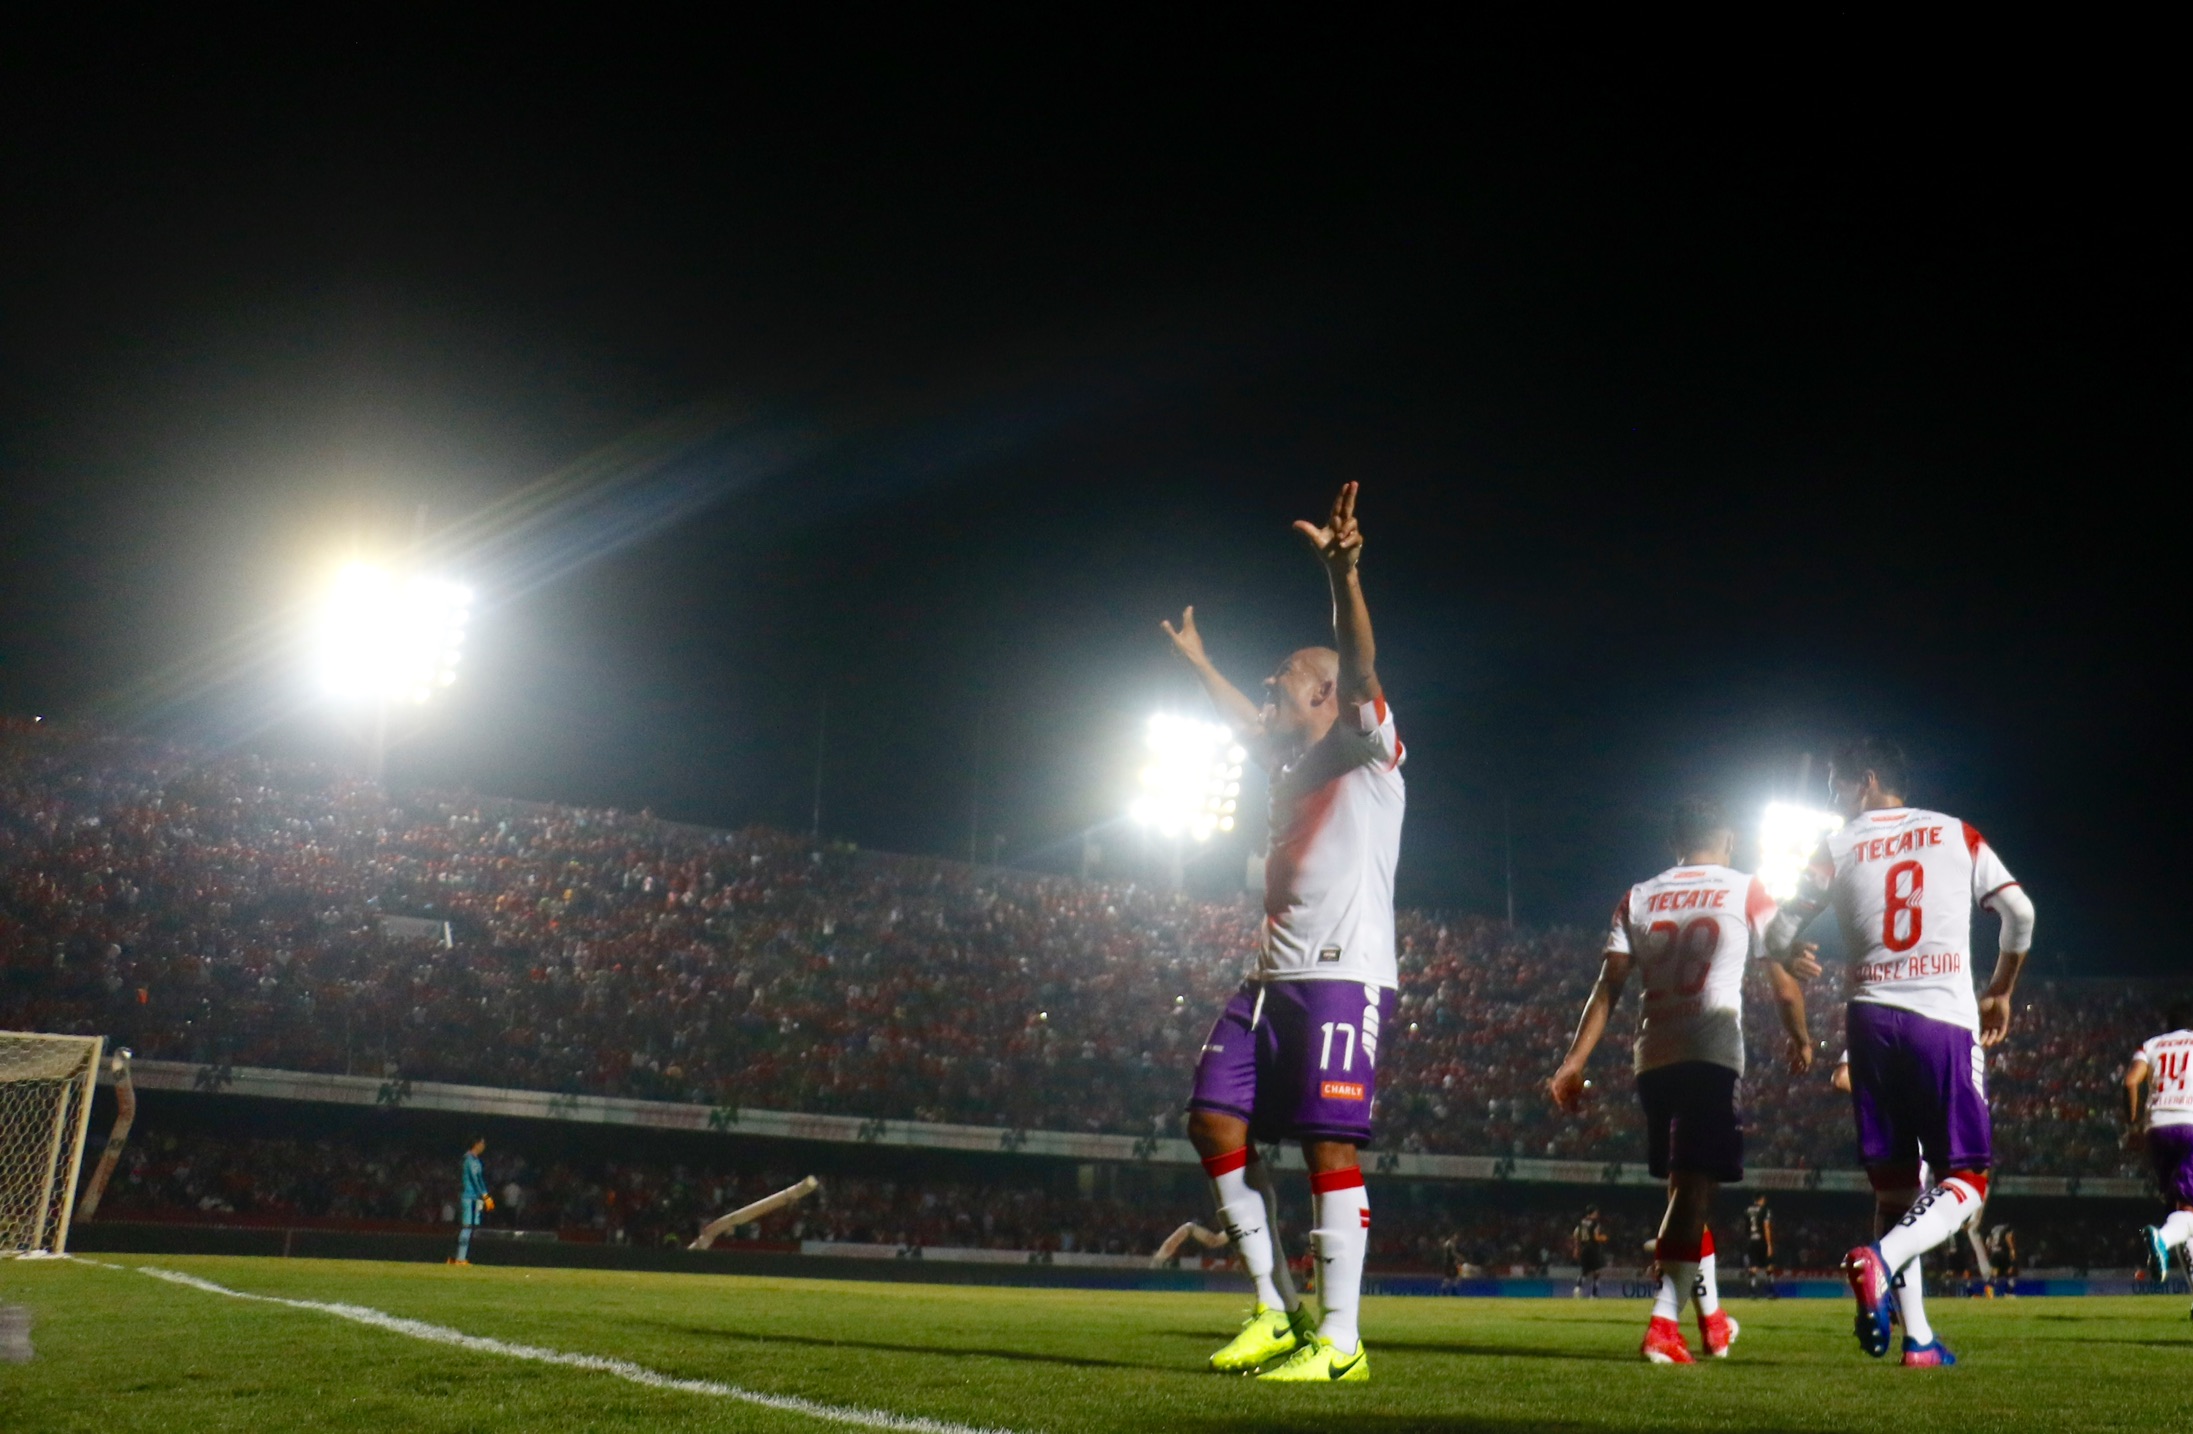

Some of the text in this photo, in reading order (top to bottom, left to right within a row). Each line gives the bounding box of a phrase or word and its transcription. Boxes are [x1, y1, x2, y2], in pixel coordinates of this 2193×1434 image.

[1853, 826, 1943, 863] TECATE
[1647, 889, 1730, 913] TECATE
[1882, 860, 1924, 953] 8
[1909, 953, 1961, 977] REYNA
[1320, 1022, 1355, 1071] 17
[1324, 1084, 1362, 1096] CHARLY
[2158, 1051, 2189, 1093] 14
